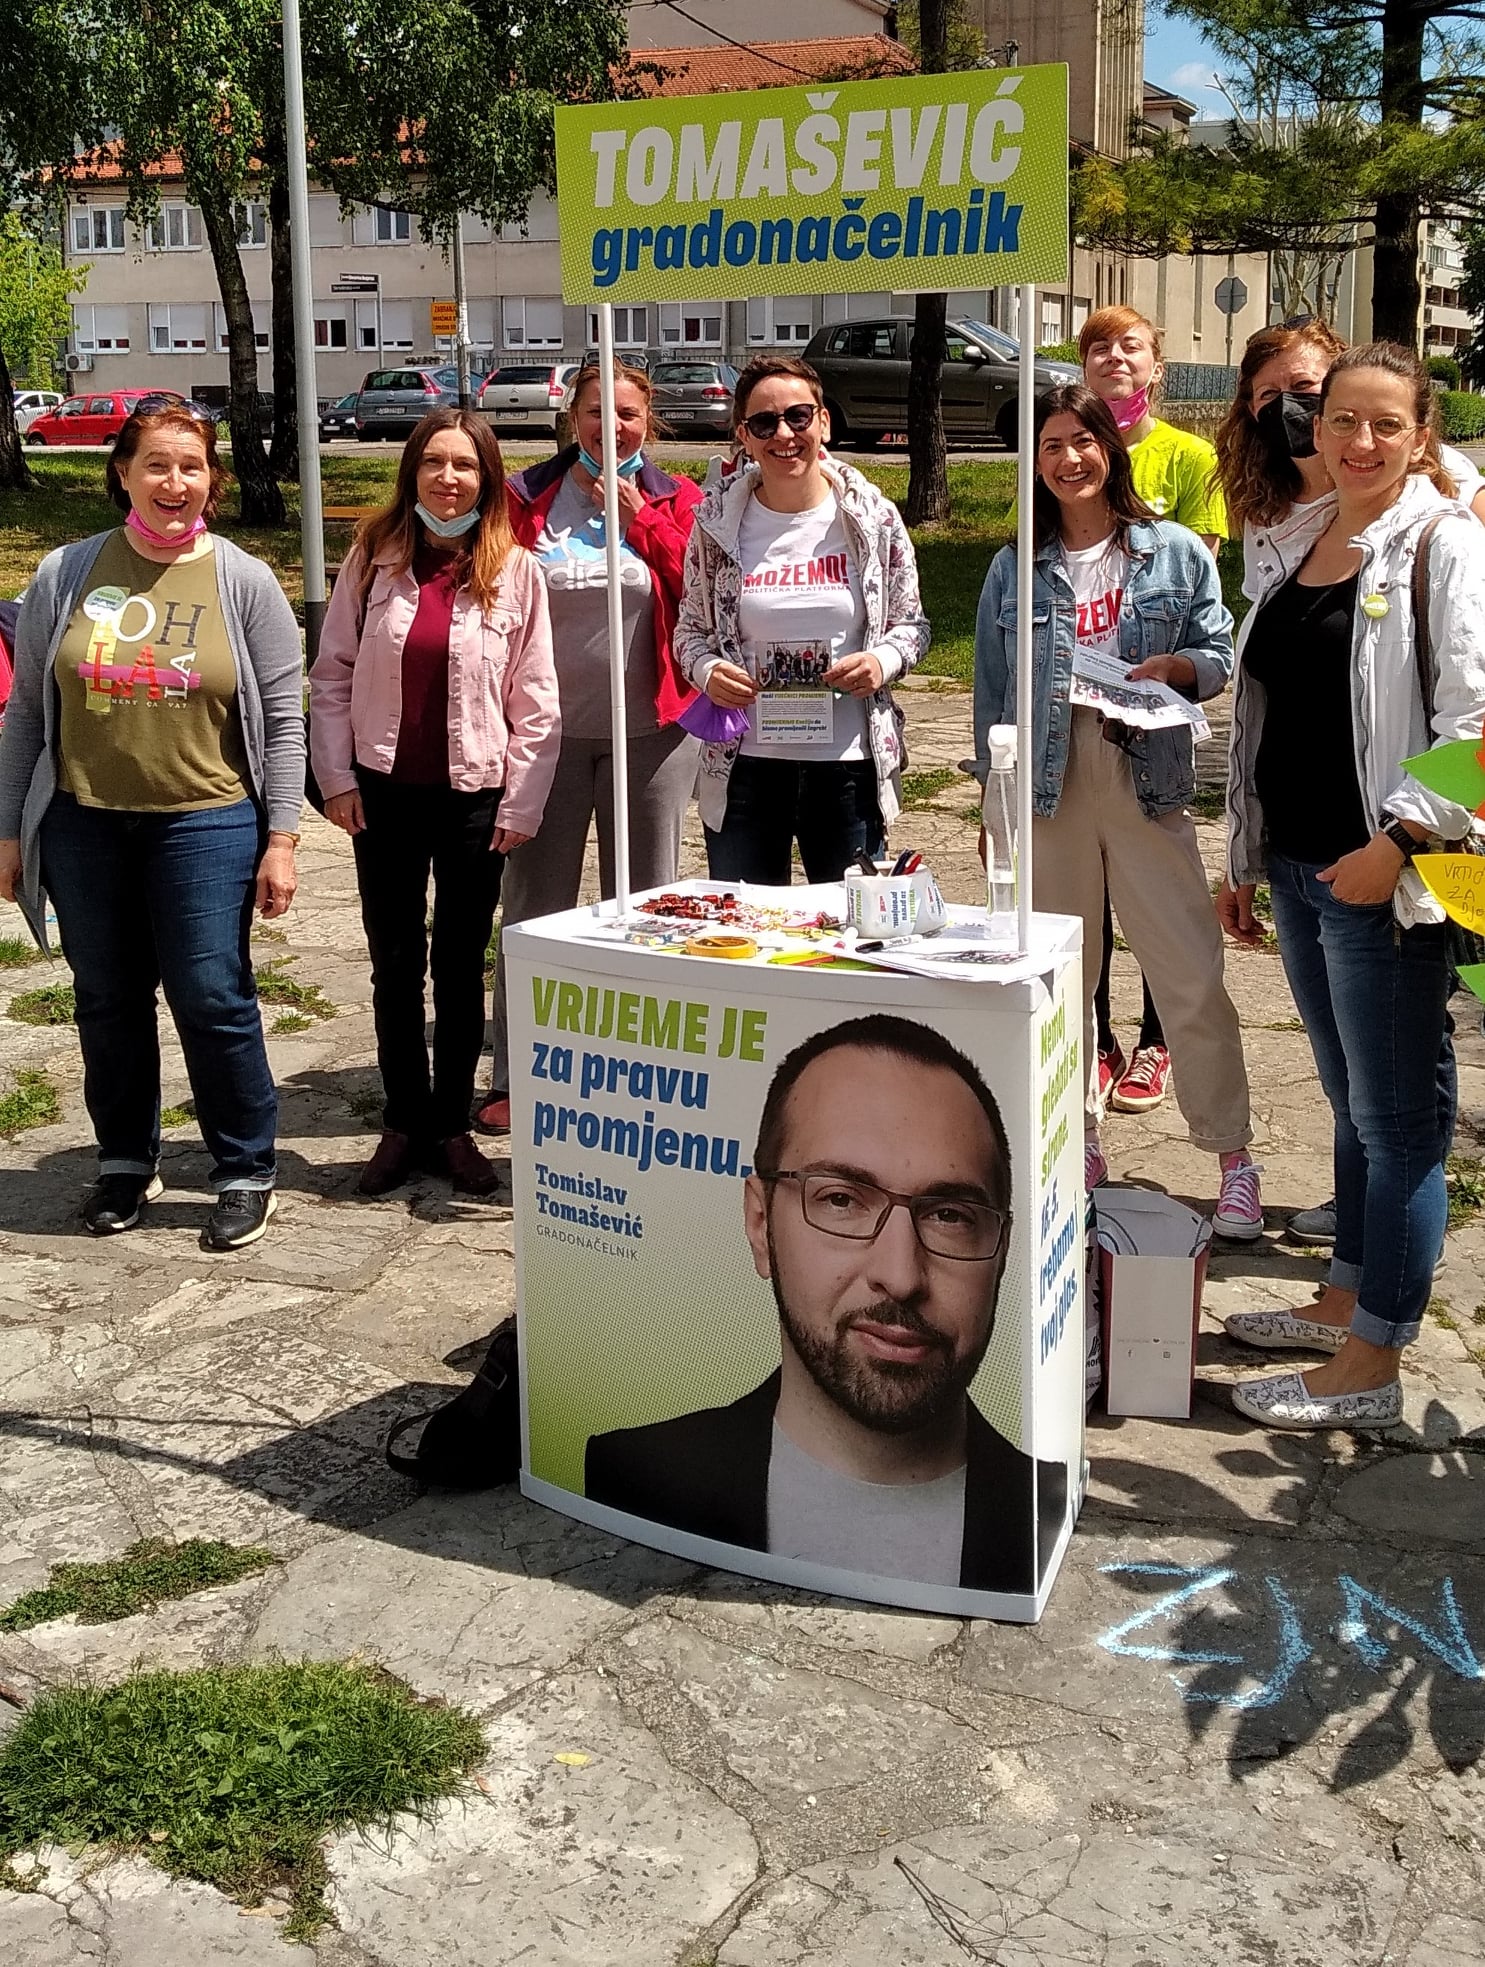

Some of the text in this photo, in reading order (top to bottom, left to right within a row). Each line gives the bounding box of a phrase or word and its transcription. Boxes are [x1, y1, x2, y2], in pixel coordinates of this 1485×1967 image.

[590, 75, 1025, 208] TOMAŠEVIĆ
[592, 189, 1024, 287] gradonačelnik
[743, 553, 850, 588] MOŽEMO!
[111, 595, 206, 648] OH
[90, 642, 162, 700] LA
[164, 651, 196, 700] LA
[1448, 886, 1476, 902] ZA
[532, 976, 768, 1062] VRIJEME JE
[1041, 988, 1066, 1068] Nemoj
[532, 1042, 709, 1110] za pravu
[1042, 1041, 1068, 1139] gledati
[533, 1100, 754, 1178] promjenu.
[1041, 1112, 1069, 1188] strane.
[535, 1163, 628, 1206] Tomislav
[536, 1192, 643, 1238] Tomašević
[1052, 1177, 1059, 1222] 5.
[536, 1224, 638, 1262] GRADONAČELNIK
[1040, 1190, 1078, 1306] trebamo i
[1041, 1268, 1078, 1366] tvoj glas.
